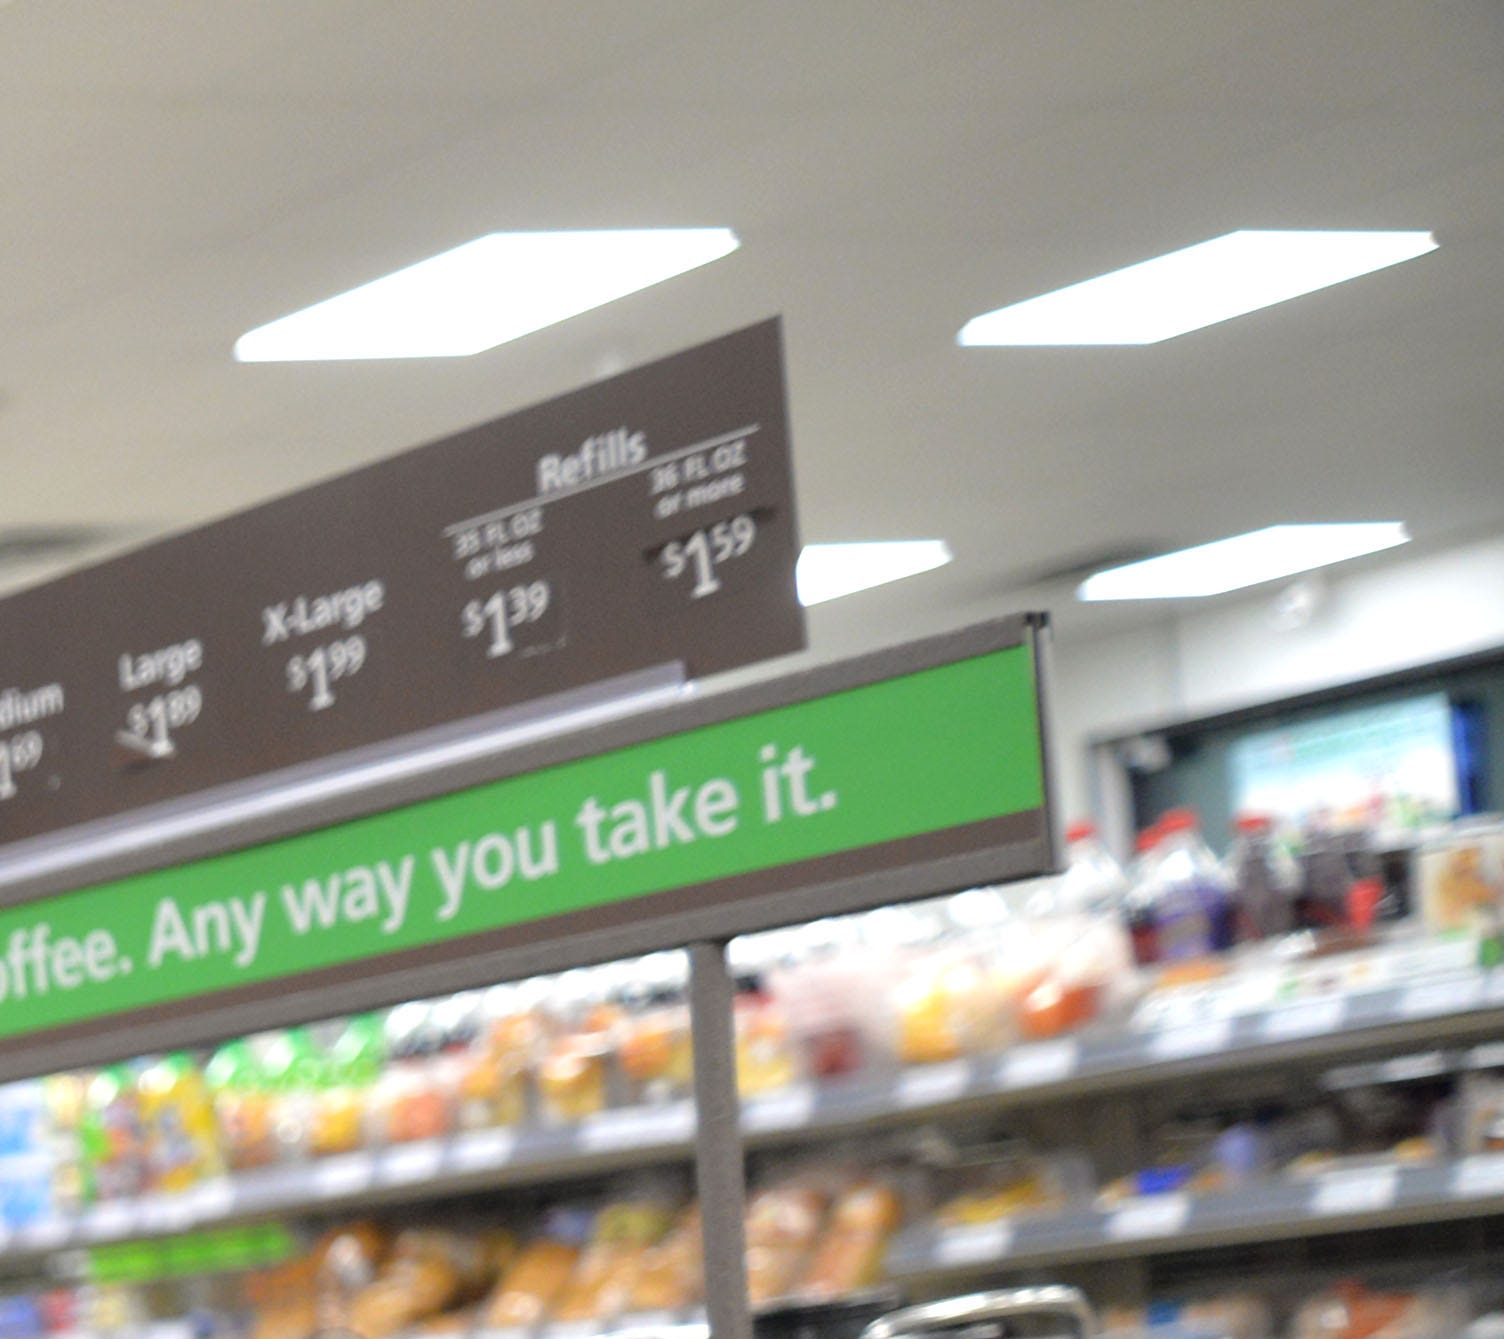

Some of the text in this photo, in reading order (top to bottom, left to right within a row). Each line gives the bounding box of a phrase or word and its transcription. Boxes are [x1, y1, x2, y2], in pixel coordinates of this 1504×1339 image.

[537, 427, 646, 491] Refills
[261, 579, 384, 646] X-Large
[118, 638, 202, 692] Large
[147, 890, 266, 967] Any
[282, 855, 414, 934] way
[431, 820, 559, 921] you
[575, 770, 739, 866] take
[758, 743, 838, 824] it.
